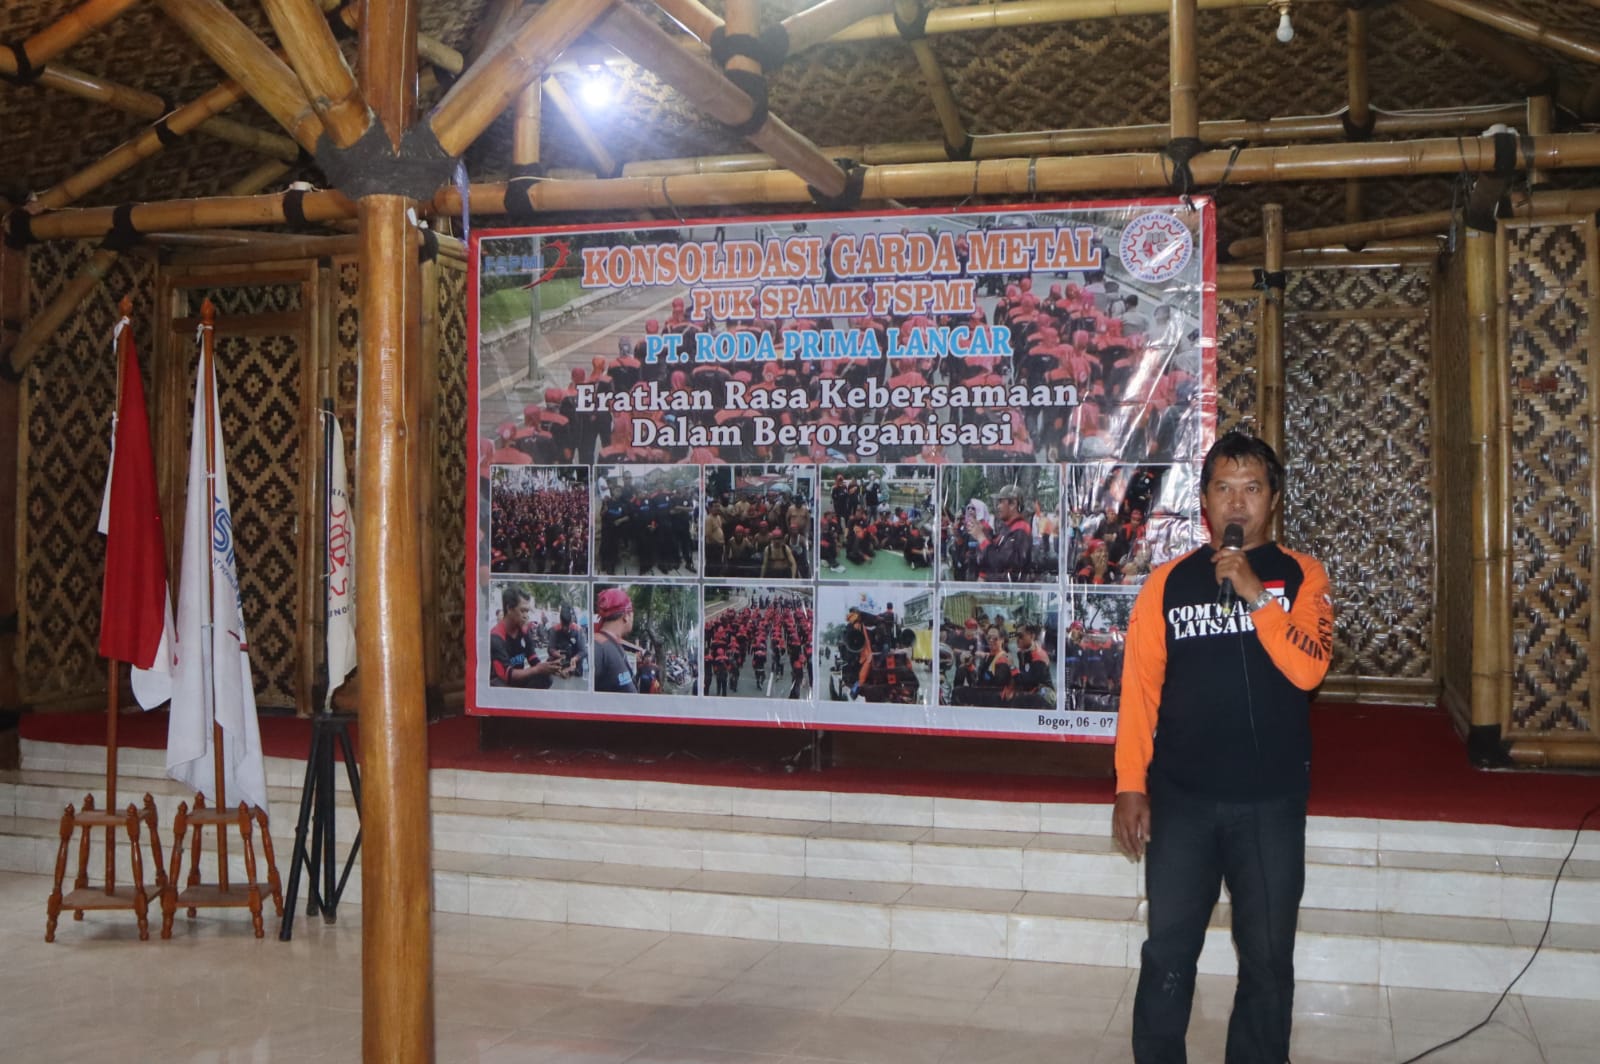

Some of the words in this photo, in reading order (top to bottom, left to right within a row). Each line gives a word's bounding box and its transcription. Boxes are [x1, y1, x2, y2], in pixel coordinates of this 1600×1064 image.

[581, 237, 823, 288] KONSOLIDASI
[830, 231, 960, 277] GARDA
[967, 227, 1101, 274] METAL
[691, 286, 756, 322] PUK
[759, 281, 868, 321] SPAMK
[872, 279, 975, 317] FSPMI
[645, 334, 690, 365] PT.
[695, 331, 775, 363] RODA
[783, 329, 880, 361] PRIMA
[887, 325, 1014, 358] LANCAR
[575, 379, 713, 412] Eratkan
[724, 380, 808, 411] Rasa
[819, 376, 1080, 409] Kebersamaan
[631, 416, 743, 448] Dalam
[753, 414, 1015, 455] Berorganisasi
[1173, 614, 1255, 640] LATSAR
[1038, 714, 1073, 729] Bogor,
[1076, 716, 1090, 728] 06
[1099, 717, 1114, 729] 07
